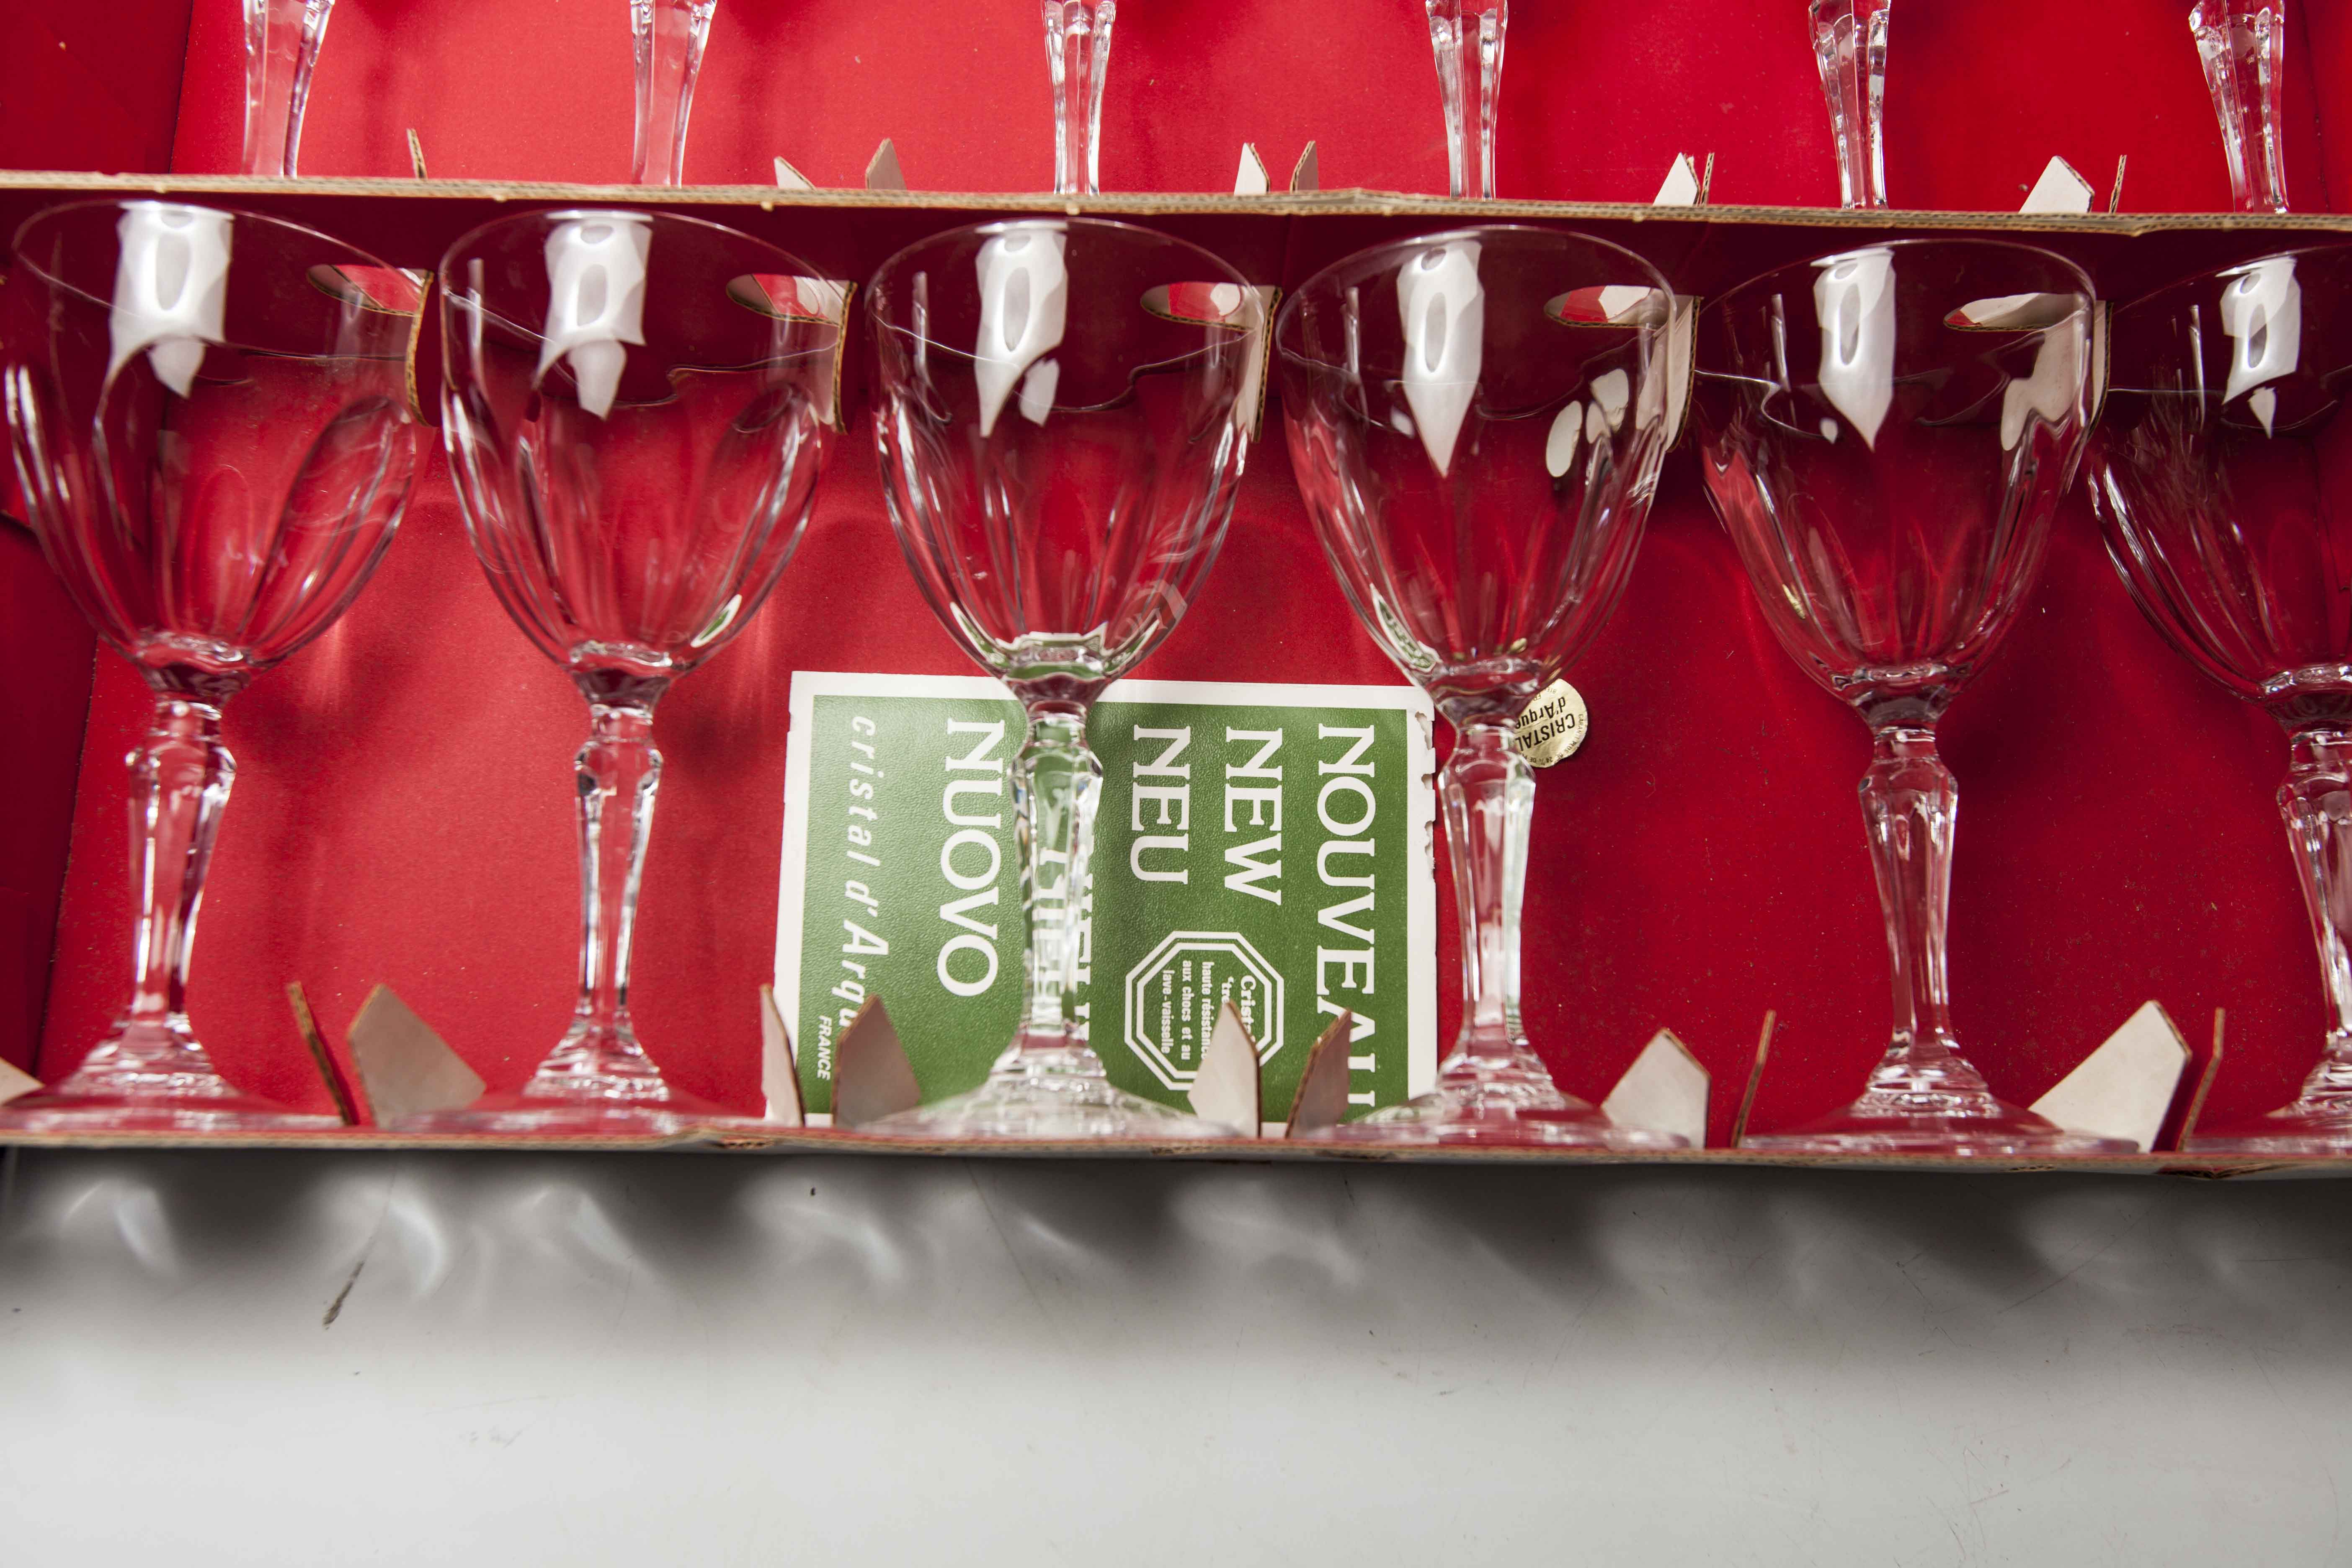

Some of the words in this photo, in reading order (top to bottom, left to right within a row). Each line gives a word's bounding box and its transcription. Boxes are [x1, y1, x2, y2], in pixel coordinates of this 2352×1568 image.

[1514, 713, 1575, 751] CRISTAL
[1515, 697, 1566, 729] d'Arque
[845, 716, 884, 867] cristal
[1130, 725, 1190, 885] NEU
[1224, 726, 1283, 905] NEW
[936, 718, 1006, 997] NUOVO
[831, 880, 890, 1028] d'Arqu
[1182, 960, 1194, 981] aux
[1202, 962, 1214, 995] haute
[1161, 970, 1175, 1054] lave-vaisselle
[1181, 986, 1194, 1021] chocs
[1181, 1027, 1193, 1039] et
[1240, 975, 1256, 1042] Crist
[817, 1015, 832, 1080] FRANCE
[1181, 1044, 1192, 1060] au
